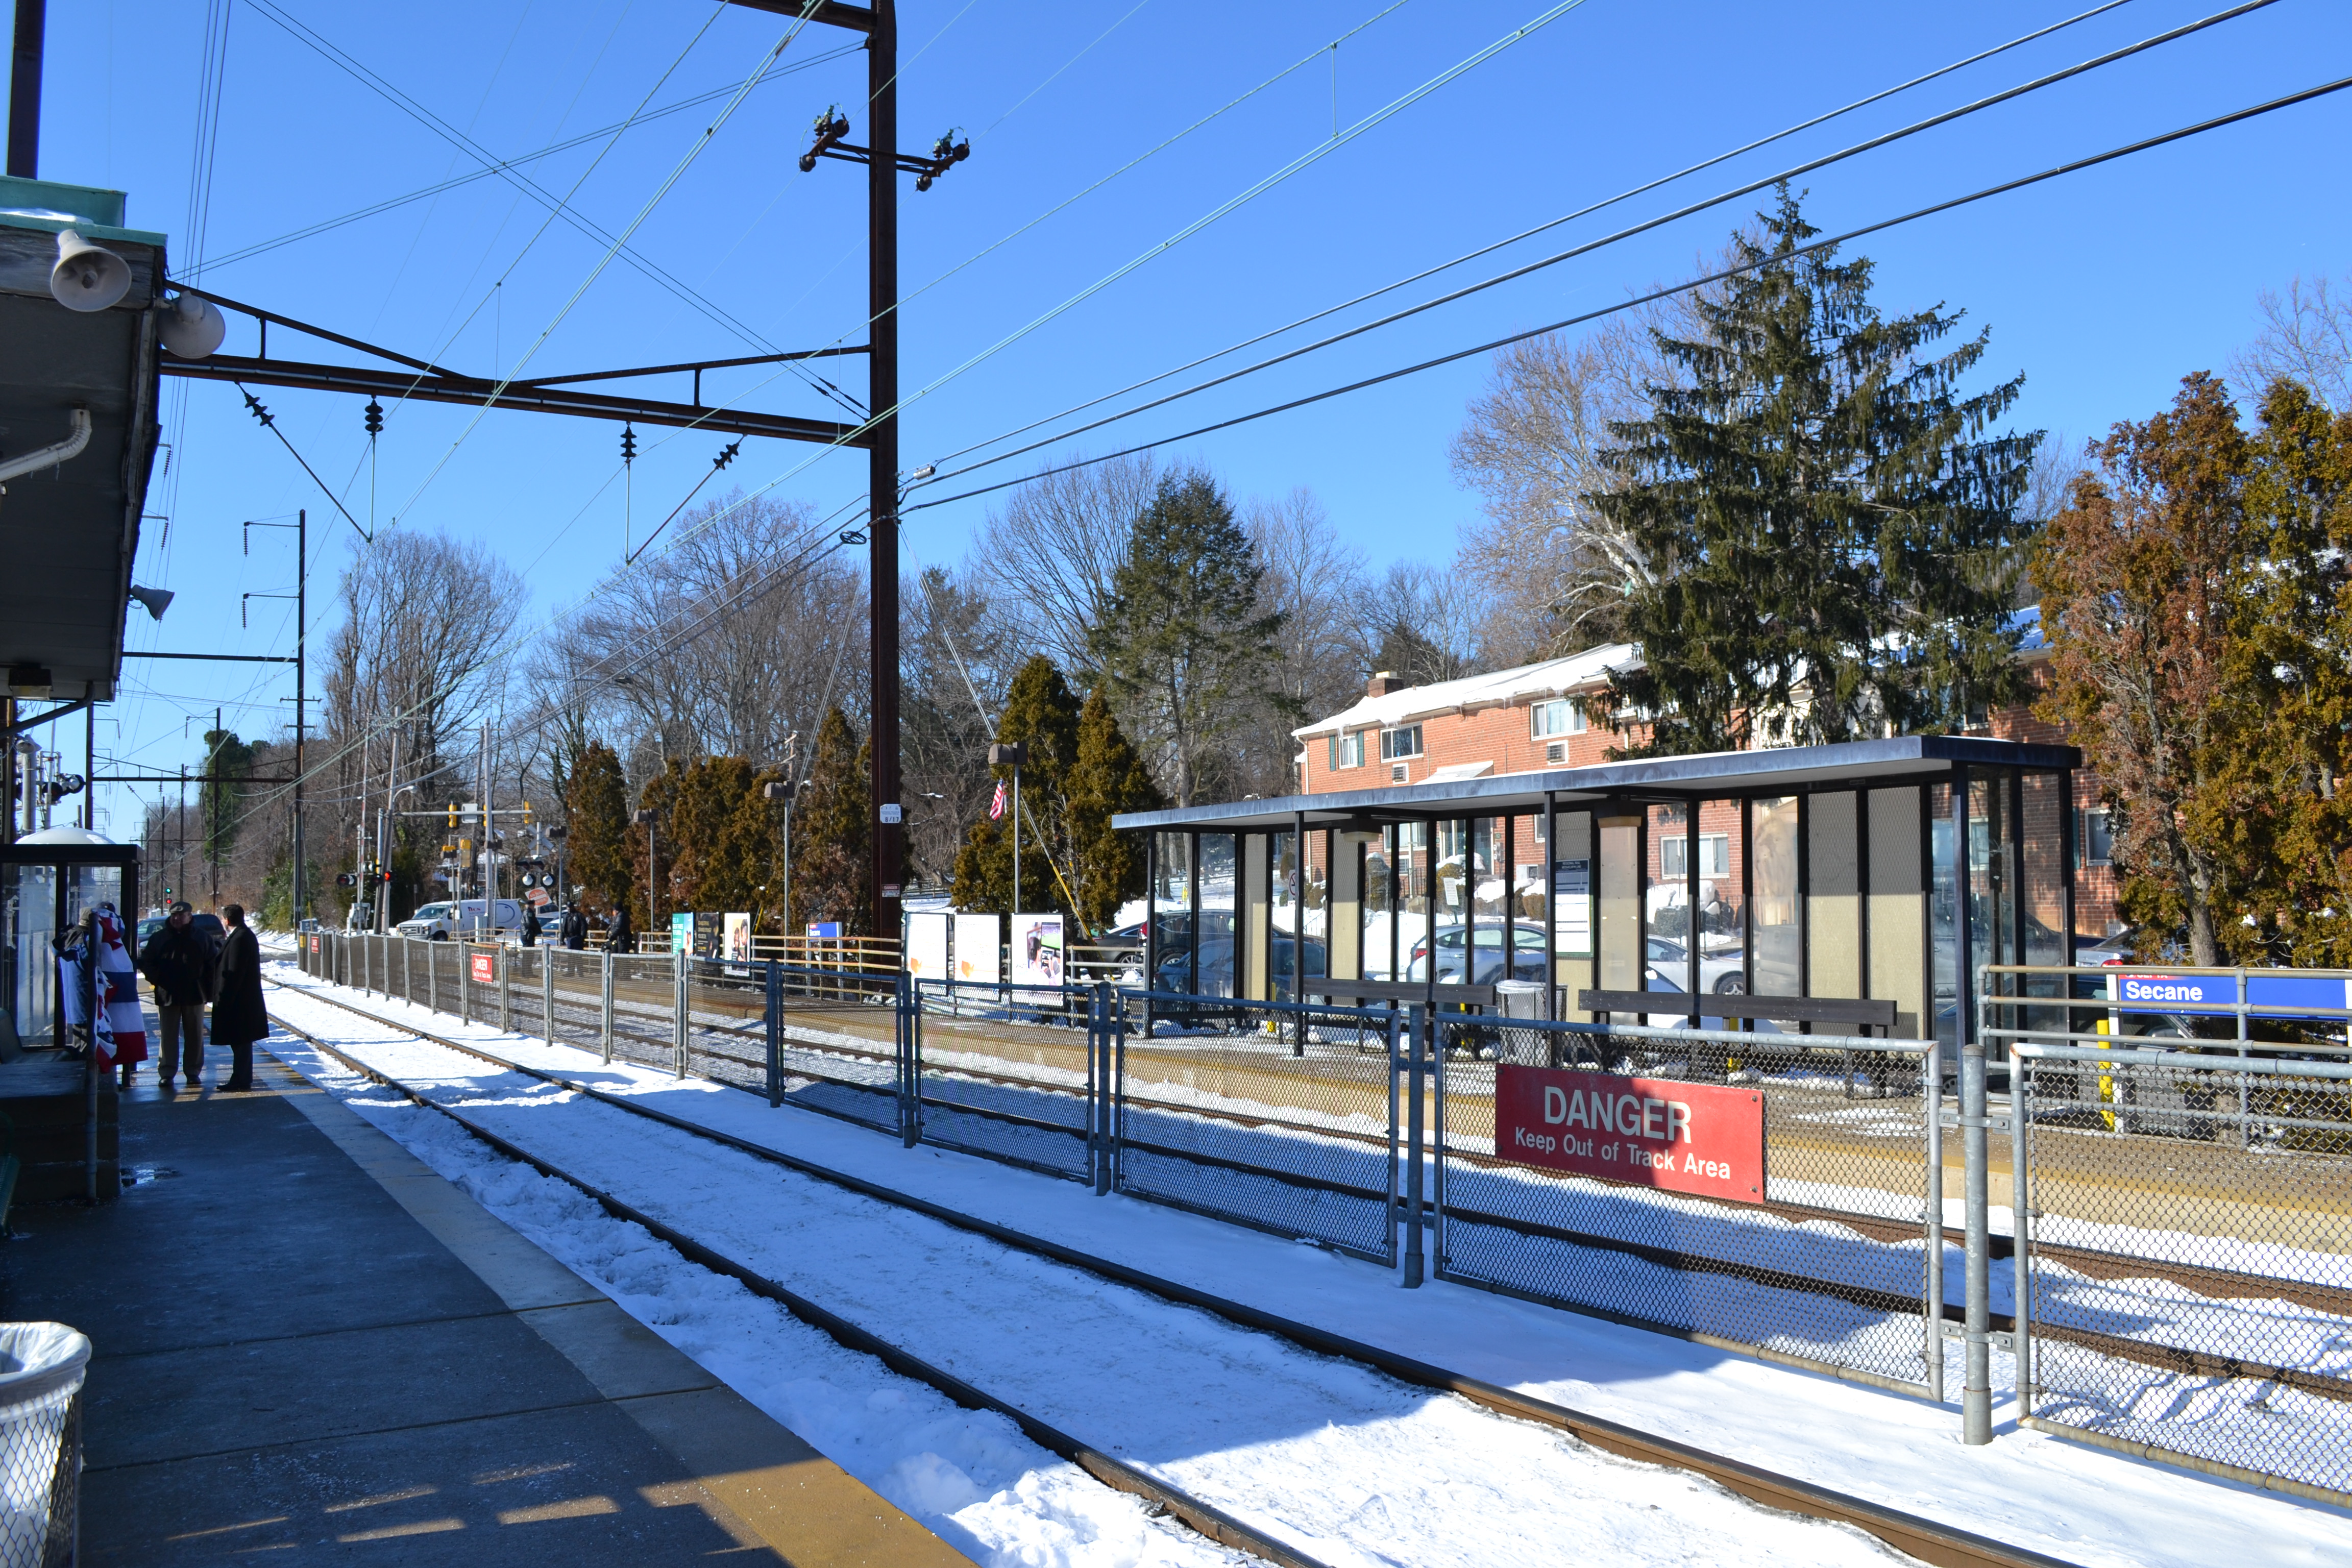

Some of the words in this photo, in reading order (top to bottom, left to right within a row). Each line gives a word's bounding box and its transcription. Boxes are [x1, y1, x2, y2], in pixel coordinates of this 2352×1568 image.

[475, 958, 487, 971] DANGER
[2126, 981, 2203, 1001] Secane
[1545, 1086, 1692, 1143] DANGER
[1515, 1126, 1556, 1154] Keep
[1563, 1133, 1594, 1157] Out
[1601, 1141, 1619, 1162] of
[1627, 1143, 1675, 1171] Track
[1683, 1153, 1731, 1180] Area
